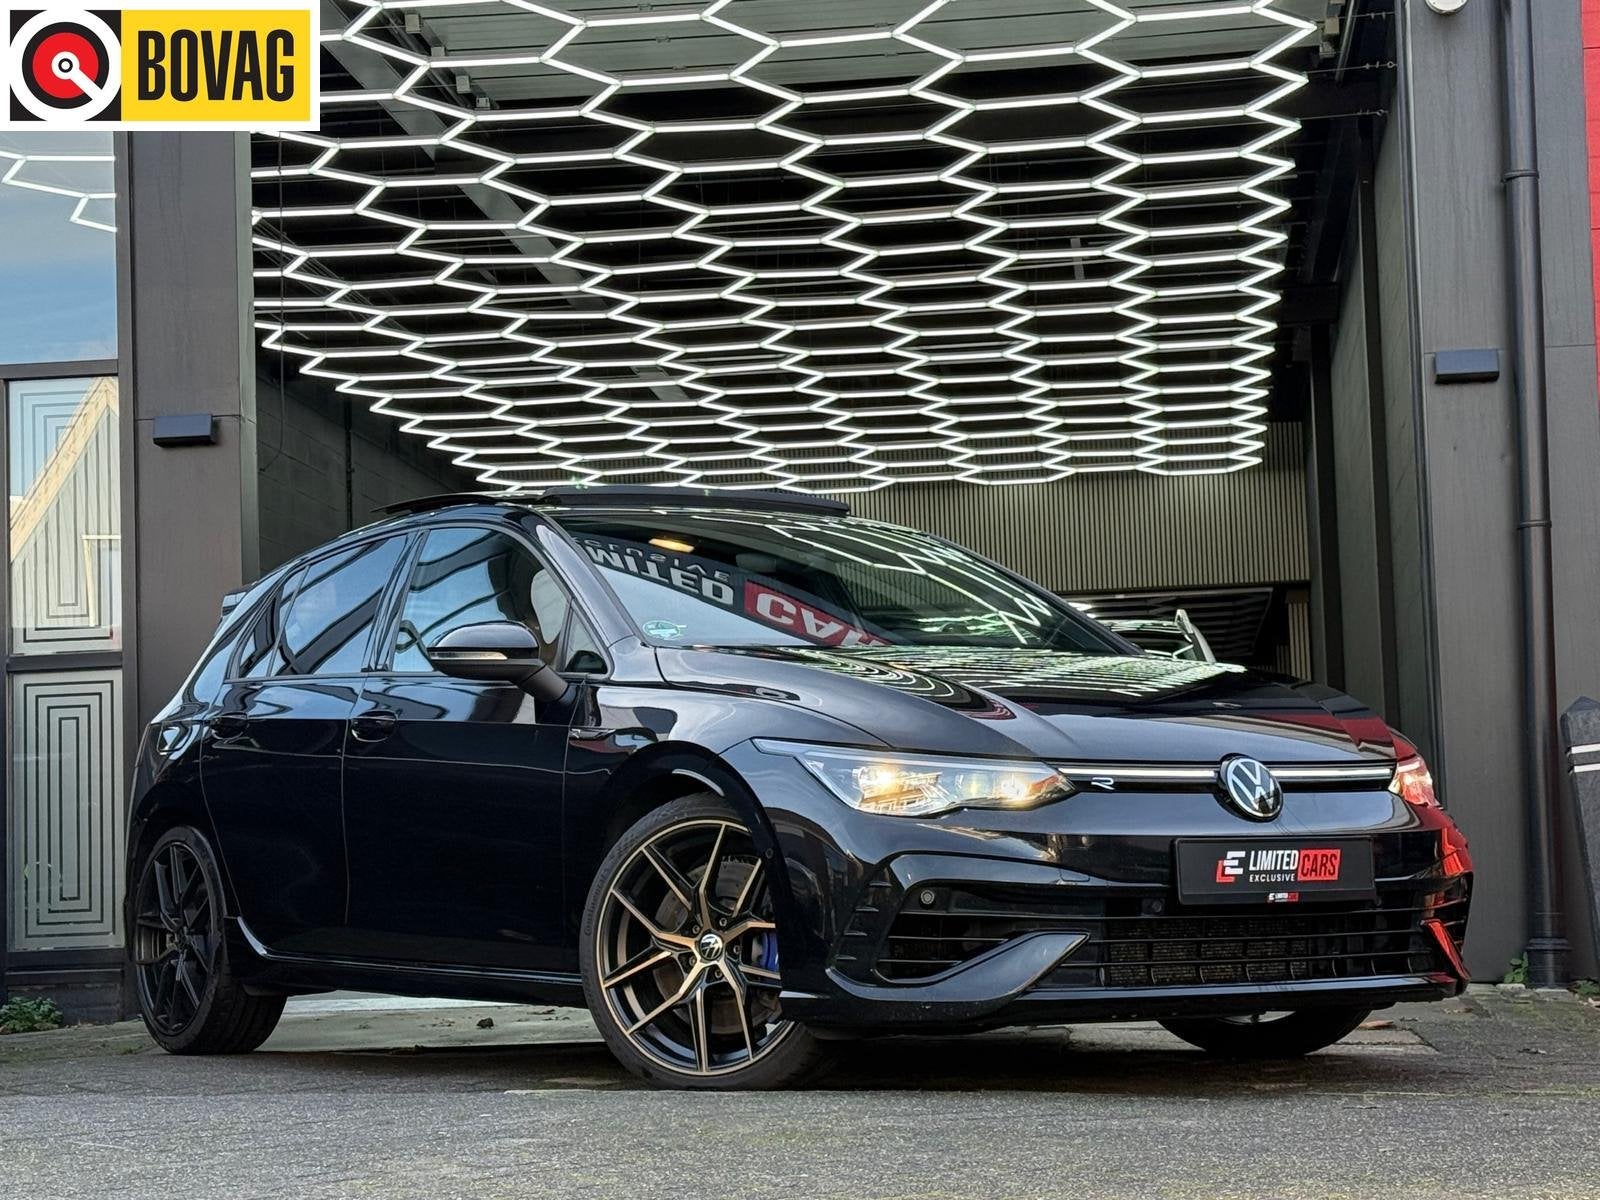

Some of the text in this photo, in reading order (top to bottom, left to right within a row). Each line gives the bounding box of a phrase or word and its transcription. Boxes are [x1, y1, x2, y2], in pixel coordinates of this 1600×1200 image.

[1249, 850, 1338, 877] LIMITED CARS
[1249, 873, 1295, 882] EXCLUSIVE
